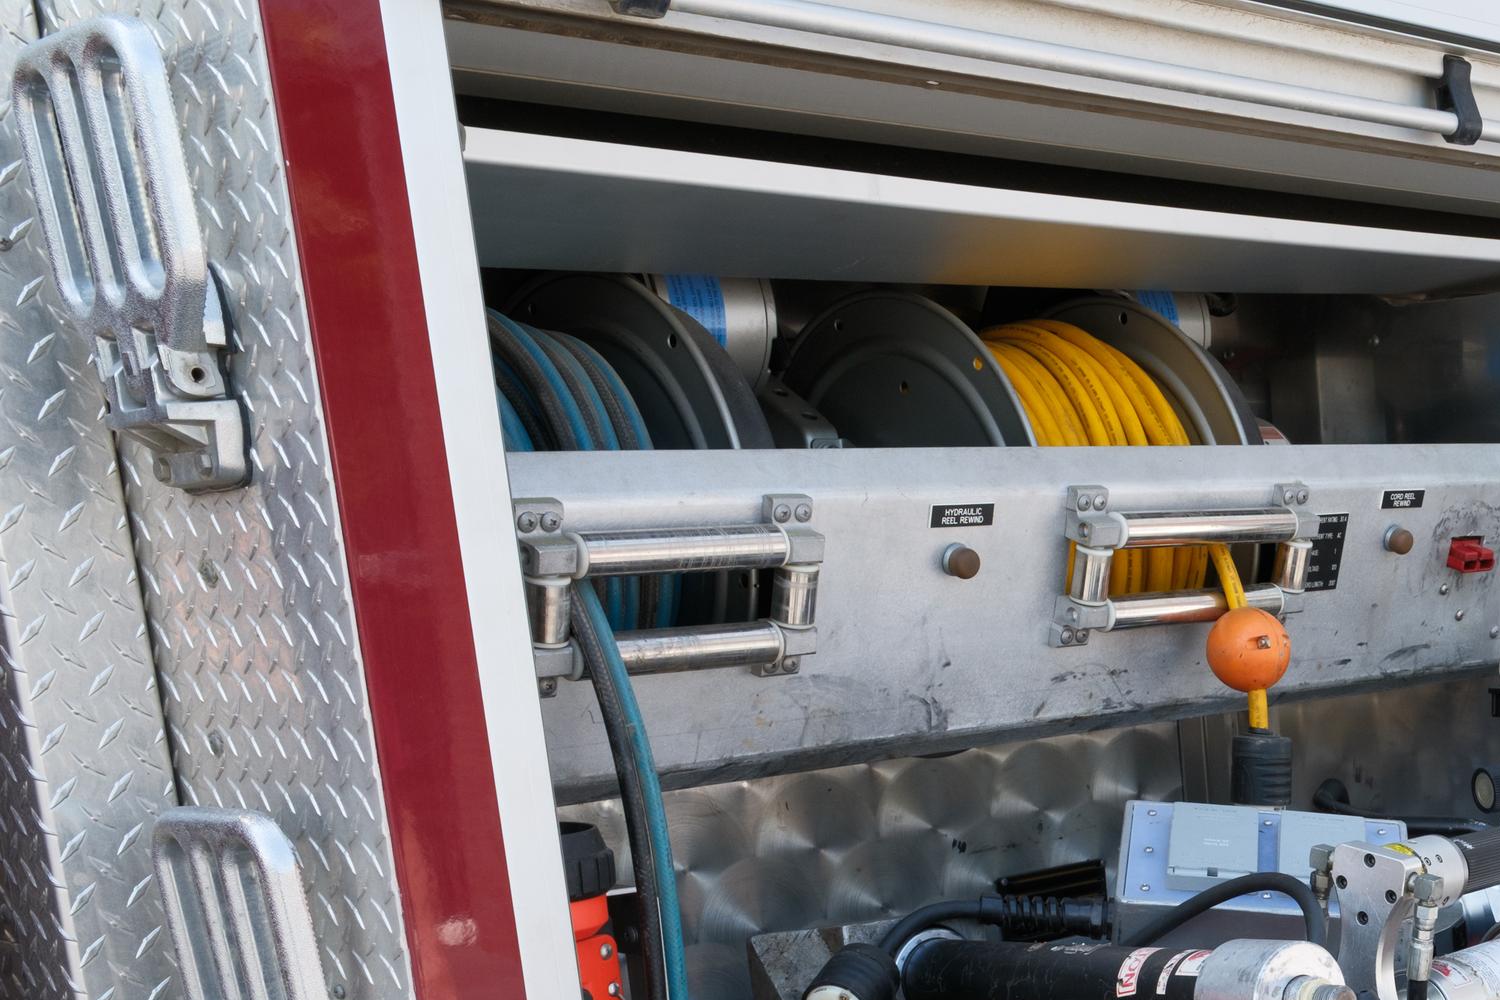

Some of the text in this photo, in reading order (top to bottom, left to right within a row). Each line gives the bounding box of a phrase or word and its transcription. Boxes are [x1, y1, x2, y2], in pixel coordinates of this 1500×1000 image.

[1404, 492, 1416, 500] REEL
[944, 507, 983, 516] HYDRAULIC
[941, 516, 984, 525] REEL REWIND
